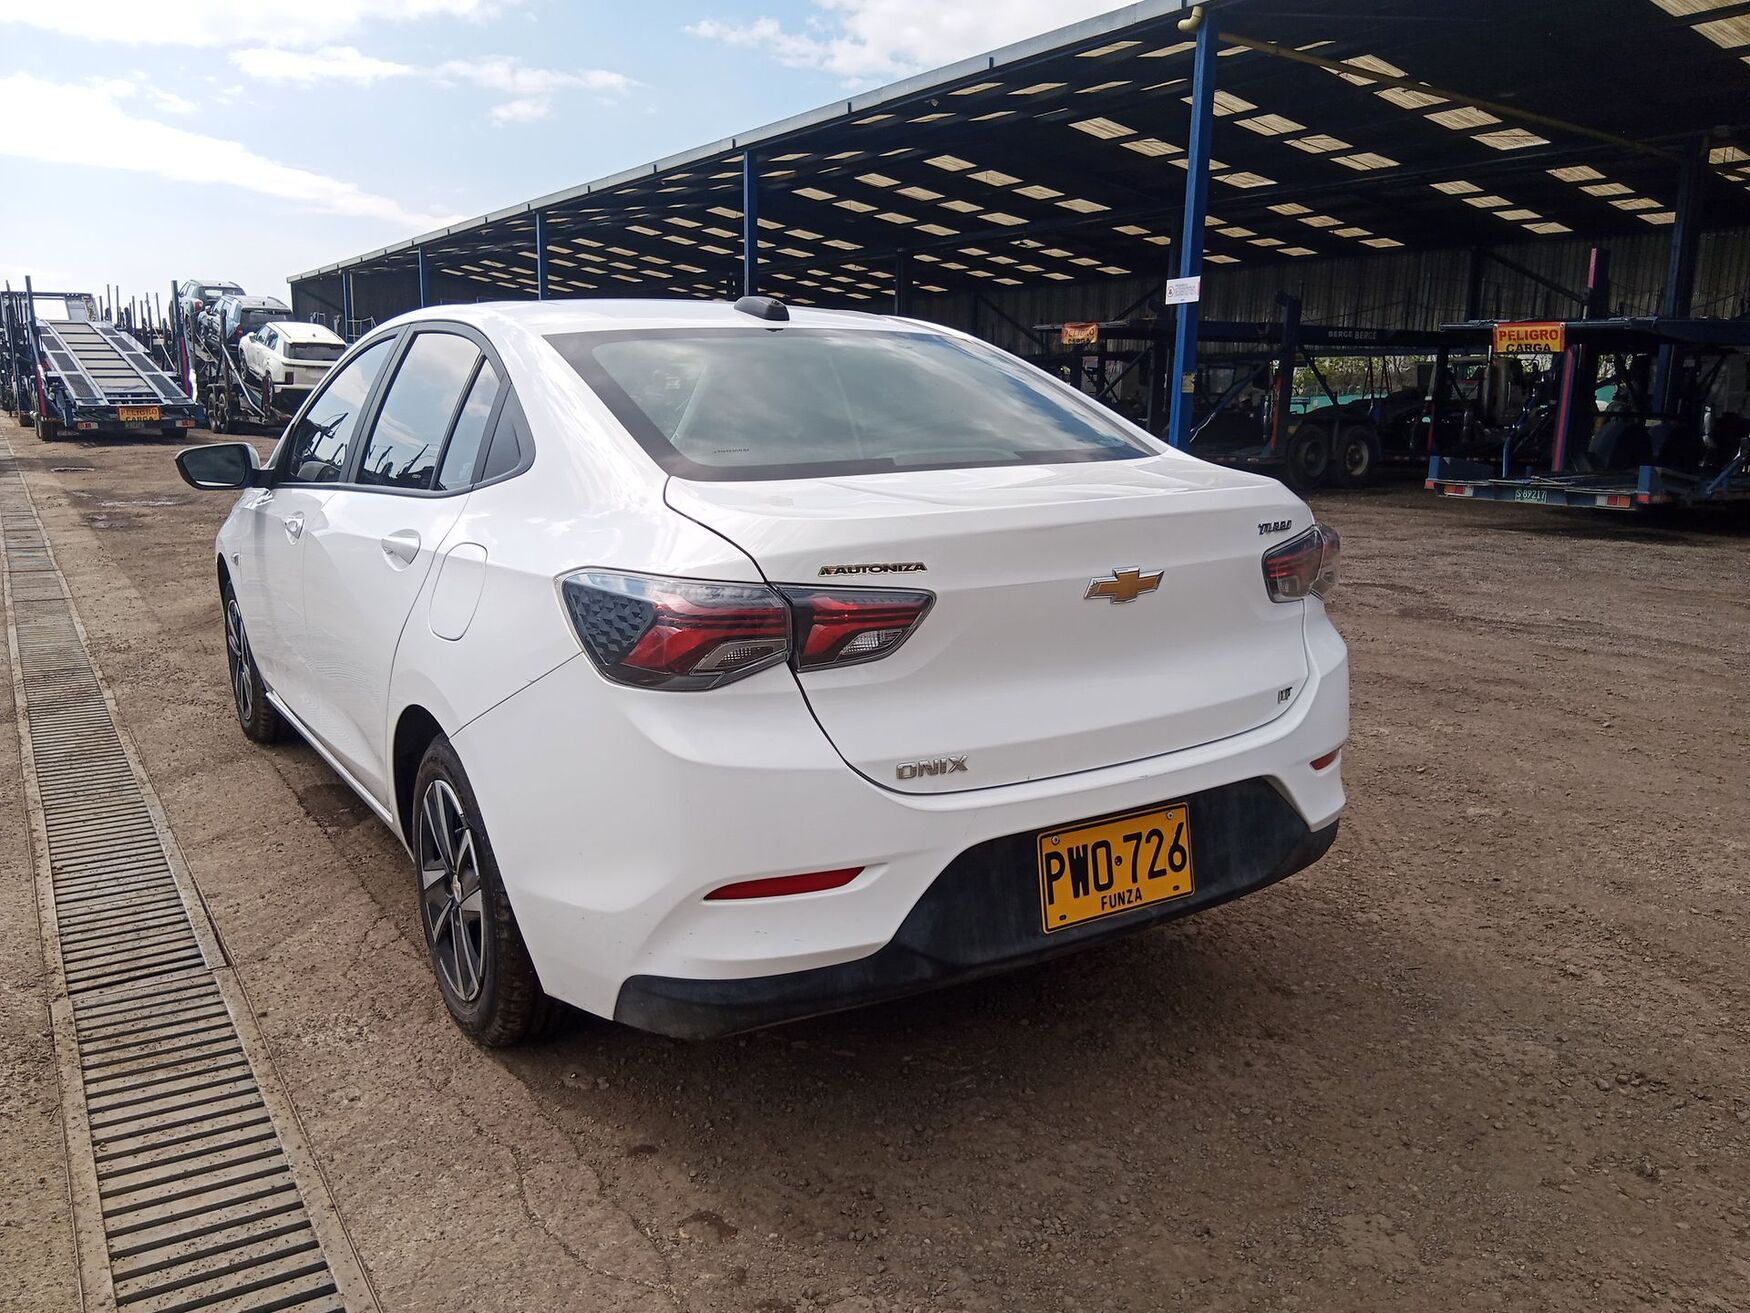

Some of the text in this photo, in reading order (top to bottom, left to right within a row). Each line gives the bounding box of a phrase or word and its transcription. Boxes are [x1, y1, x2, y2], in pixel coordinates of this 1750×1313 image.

[1499, 329, 1559, 341] PELIGRO
[1506, 343, 1552, 353] CARGA
[834, 562, 928, 575] AUTONIZA
[896, 755, 968, 780] ONIX
[1101, 887, 1142, 911] FUNZA
